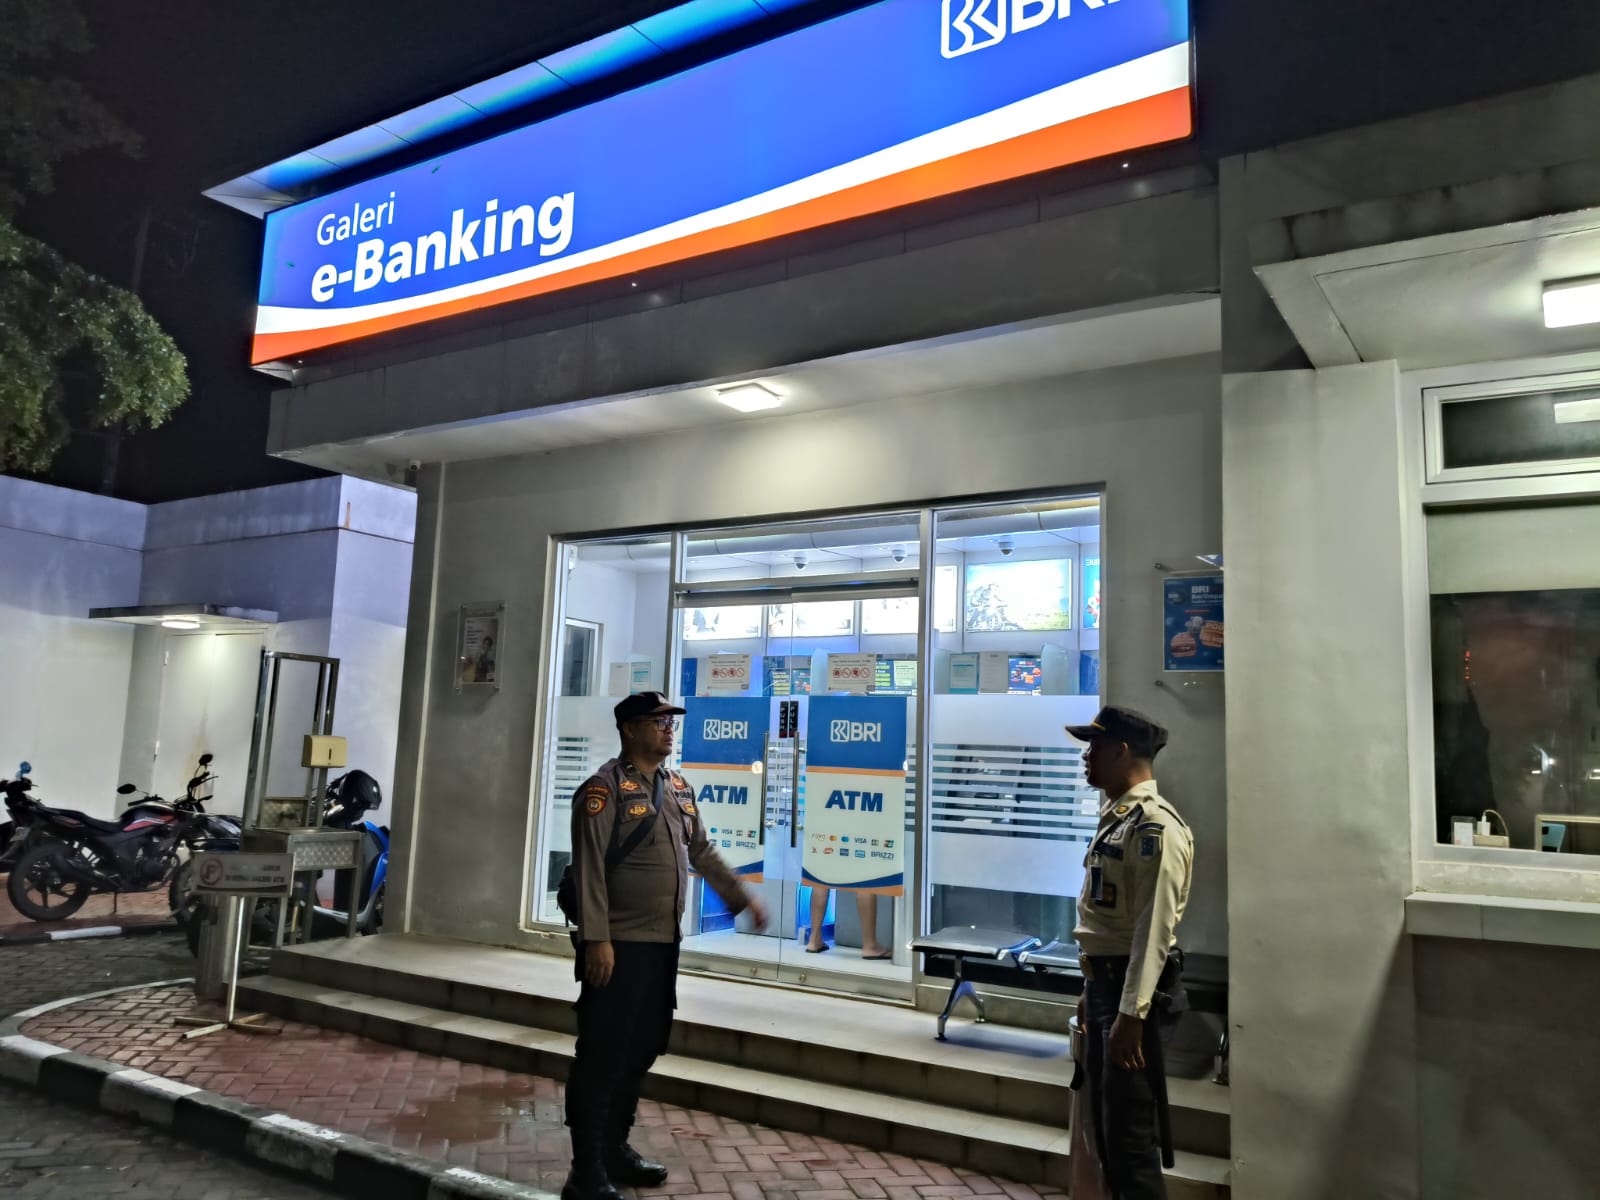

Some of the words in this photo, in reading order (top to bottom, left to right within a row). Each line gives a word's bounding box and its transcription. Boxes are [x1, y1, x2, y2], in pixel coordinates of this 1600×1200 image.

[317, 192, 395, 246] Galeri
[311, 191, 575, 302] e-Banking
[720, 720, 748, 740] BRI
[850, 721, 881, 743] BRI
[697, 784, 748, 805] ATM
[825, 789, 883, 812] ATM
[735, 841, 757, 849] BRIZZI
[870, 850, 894, 861] BRIZZI
